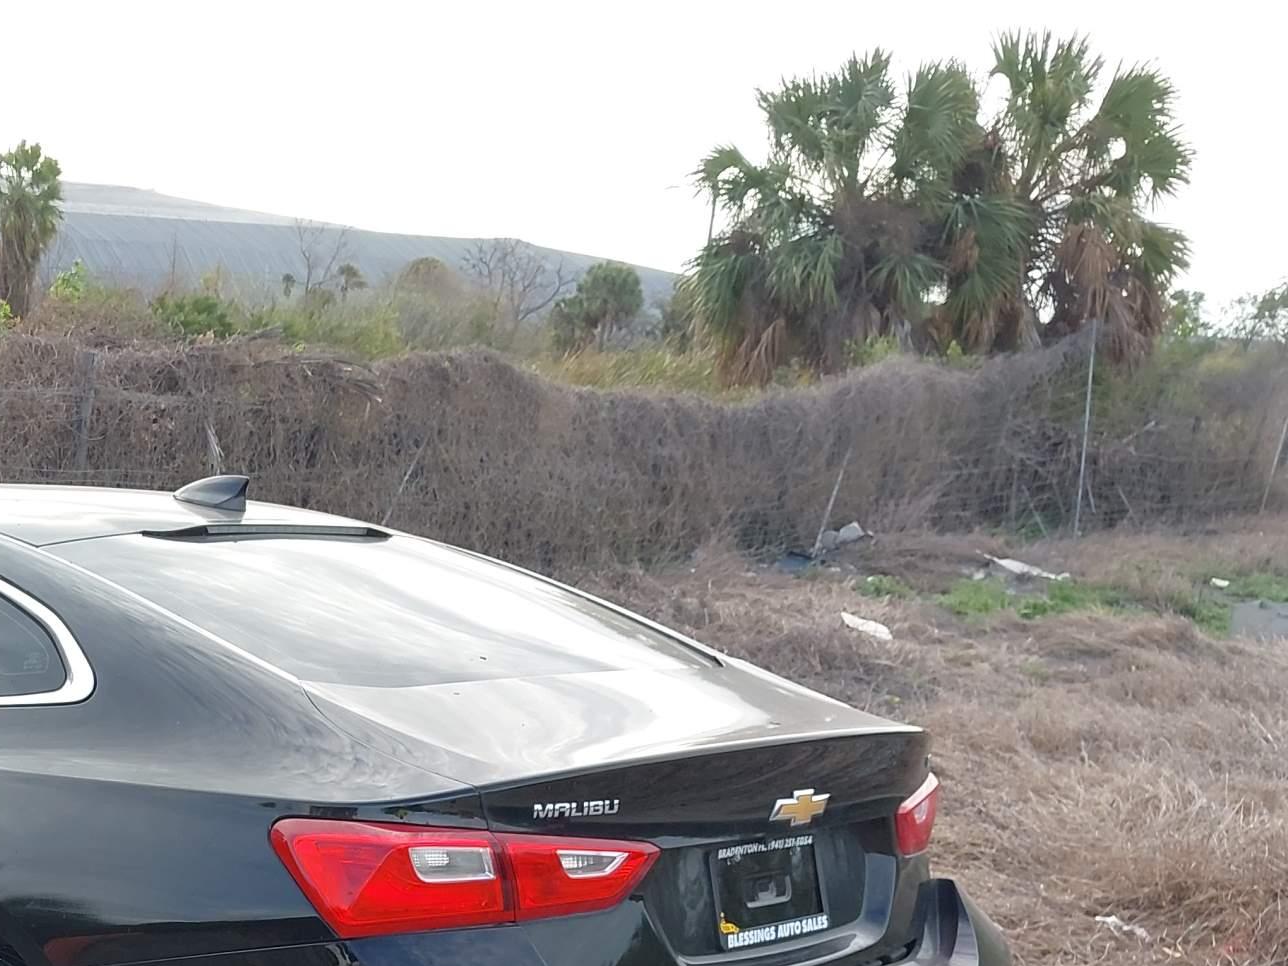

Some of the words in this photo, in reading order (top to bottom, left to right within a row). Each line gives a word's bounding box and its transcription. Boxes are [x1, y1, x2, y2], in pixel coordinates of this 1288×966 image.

[533, 799, 620, 819] MALIBU
[728, 926, 776, 949] BLESSINGS
[777, 920, 801, 939] AUTO
[801, 915, 828, 934] SALES
